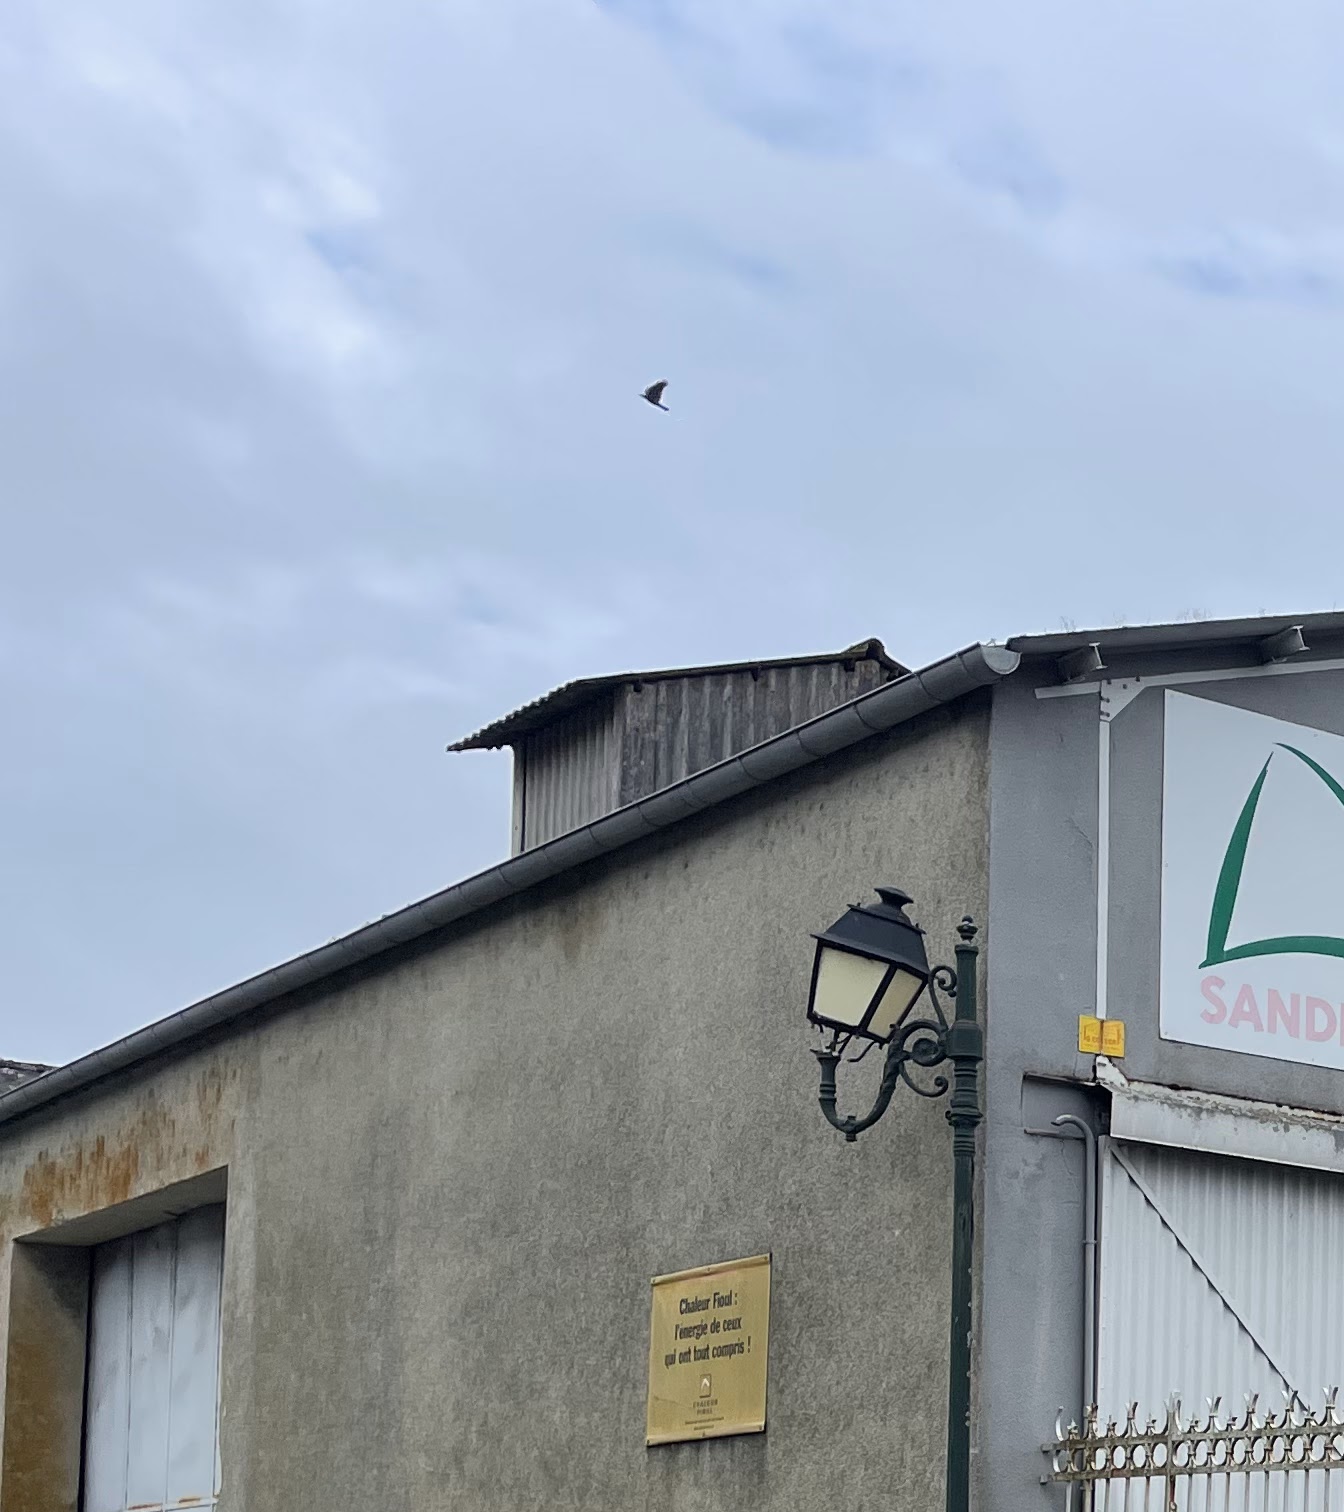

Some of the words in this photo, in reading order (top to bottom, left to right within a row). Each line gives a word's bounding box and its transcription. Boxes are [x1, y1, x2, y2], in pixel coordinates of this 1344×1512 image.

[679, 1296, 711, 1315] Chaleur
[713, 1290, 732, 1309] Fioul
[709, 1316, 721, 1334] de
[722, 1317, 742, 1332] ceux
[665, 1348, 676, 1369] qui
[678, 1346, 692, 1365] ont
[693, 1344, 710, 1362] tout
[712, 1337, 745, 1360] compris
